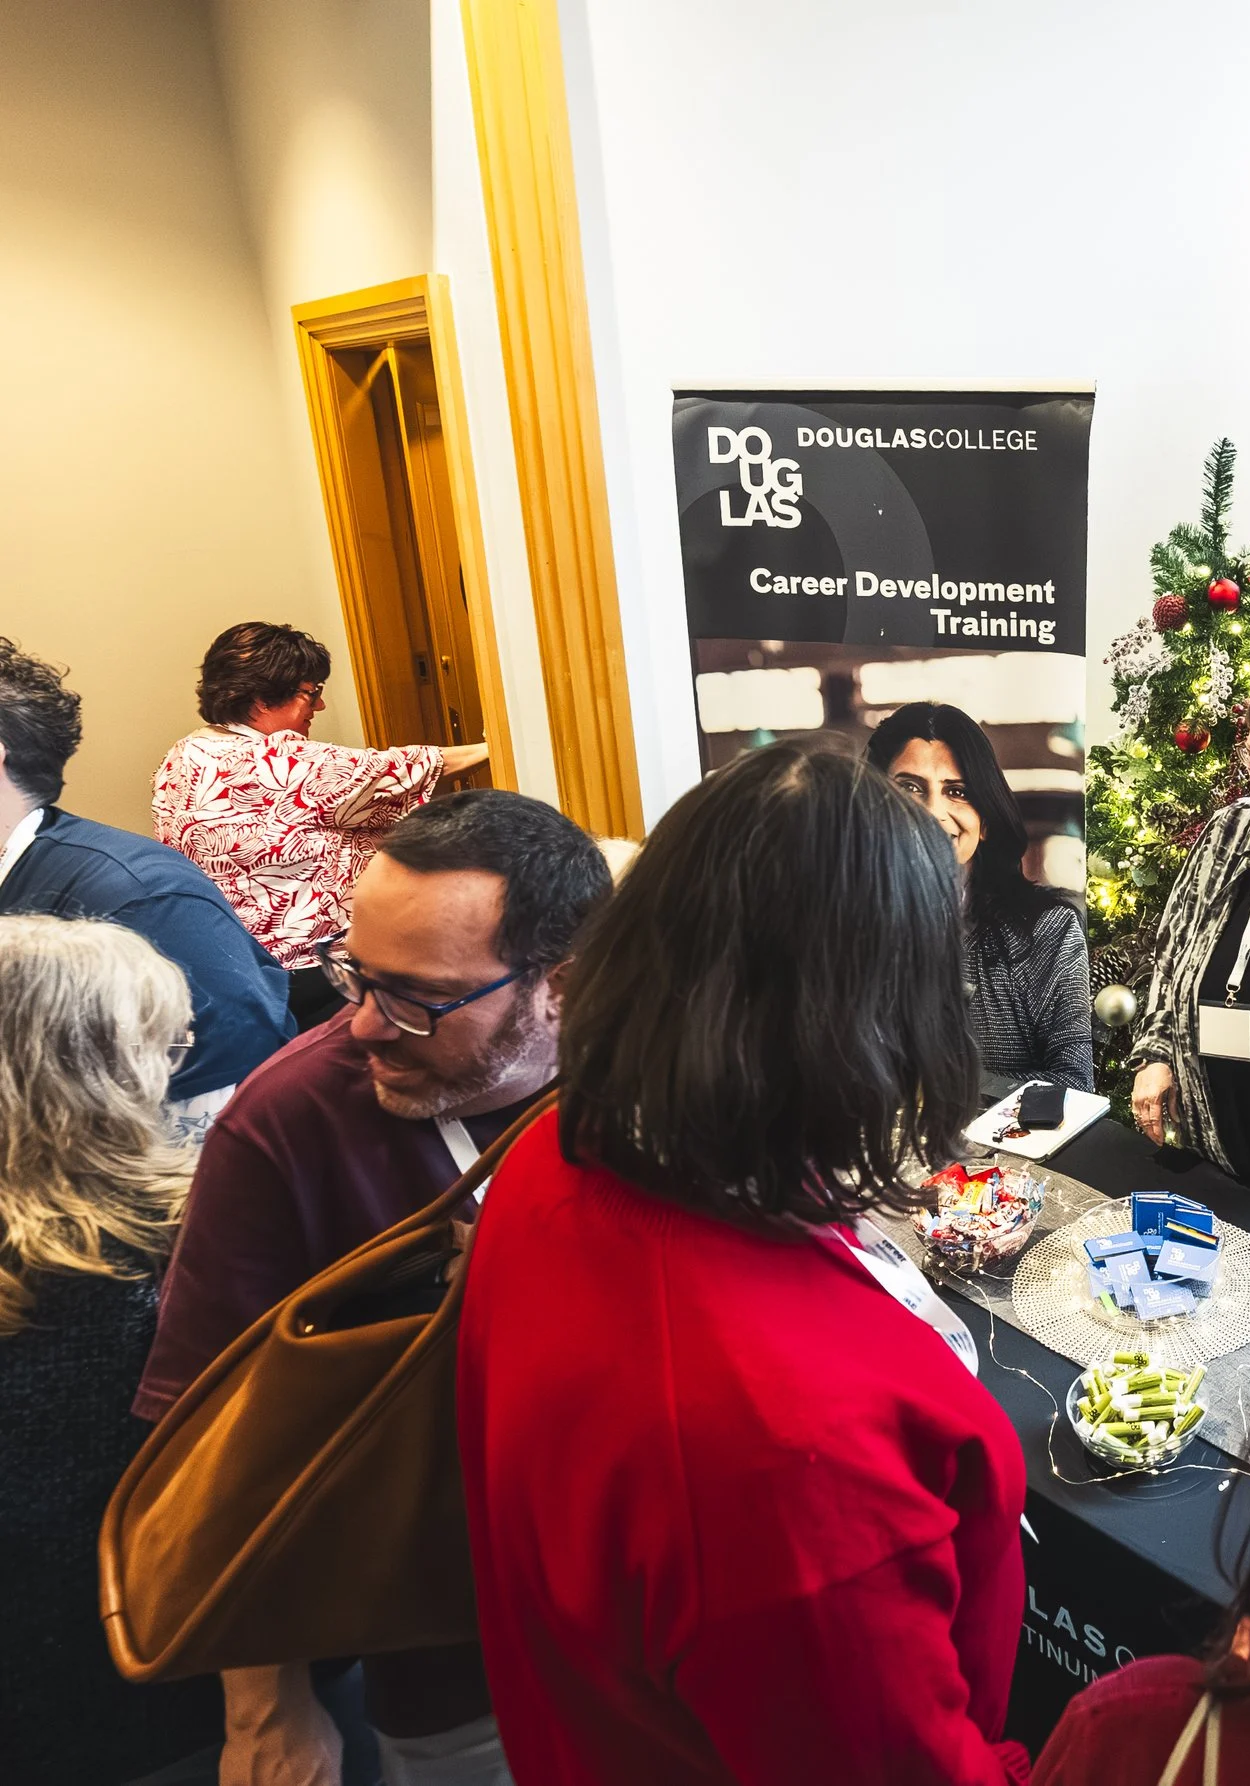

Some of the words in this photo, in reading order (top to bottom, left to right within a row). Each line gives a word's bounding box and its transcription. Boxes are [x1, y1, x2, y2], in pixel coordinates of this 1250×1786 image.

[797, 427, 1038, 451] DOUGLASCOLLEGE
[749, 567, 848, 596] Career
[855, 571, 1056, 606] Development
[930, 608, 1057, 645] Training
